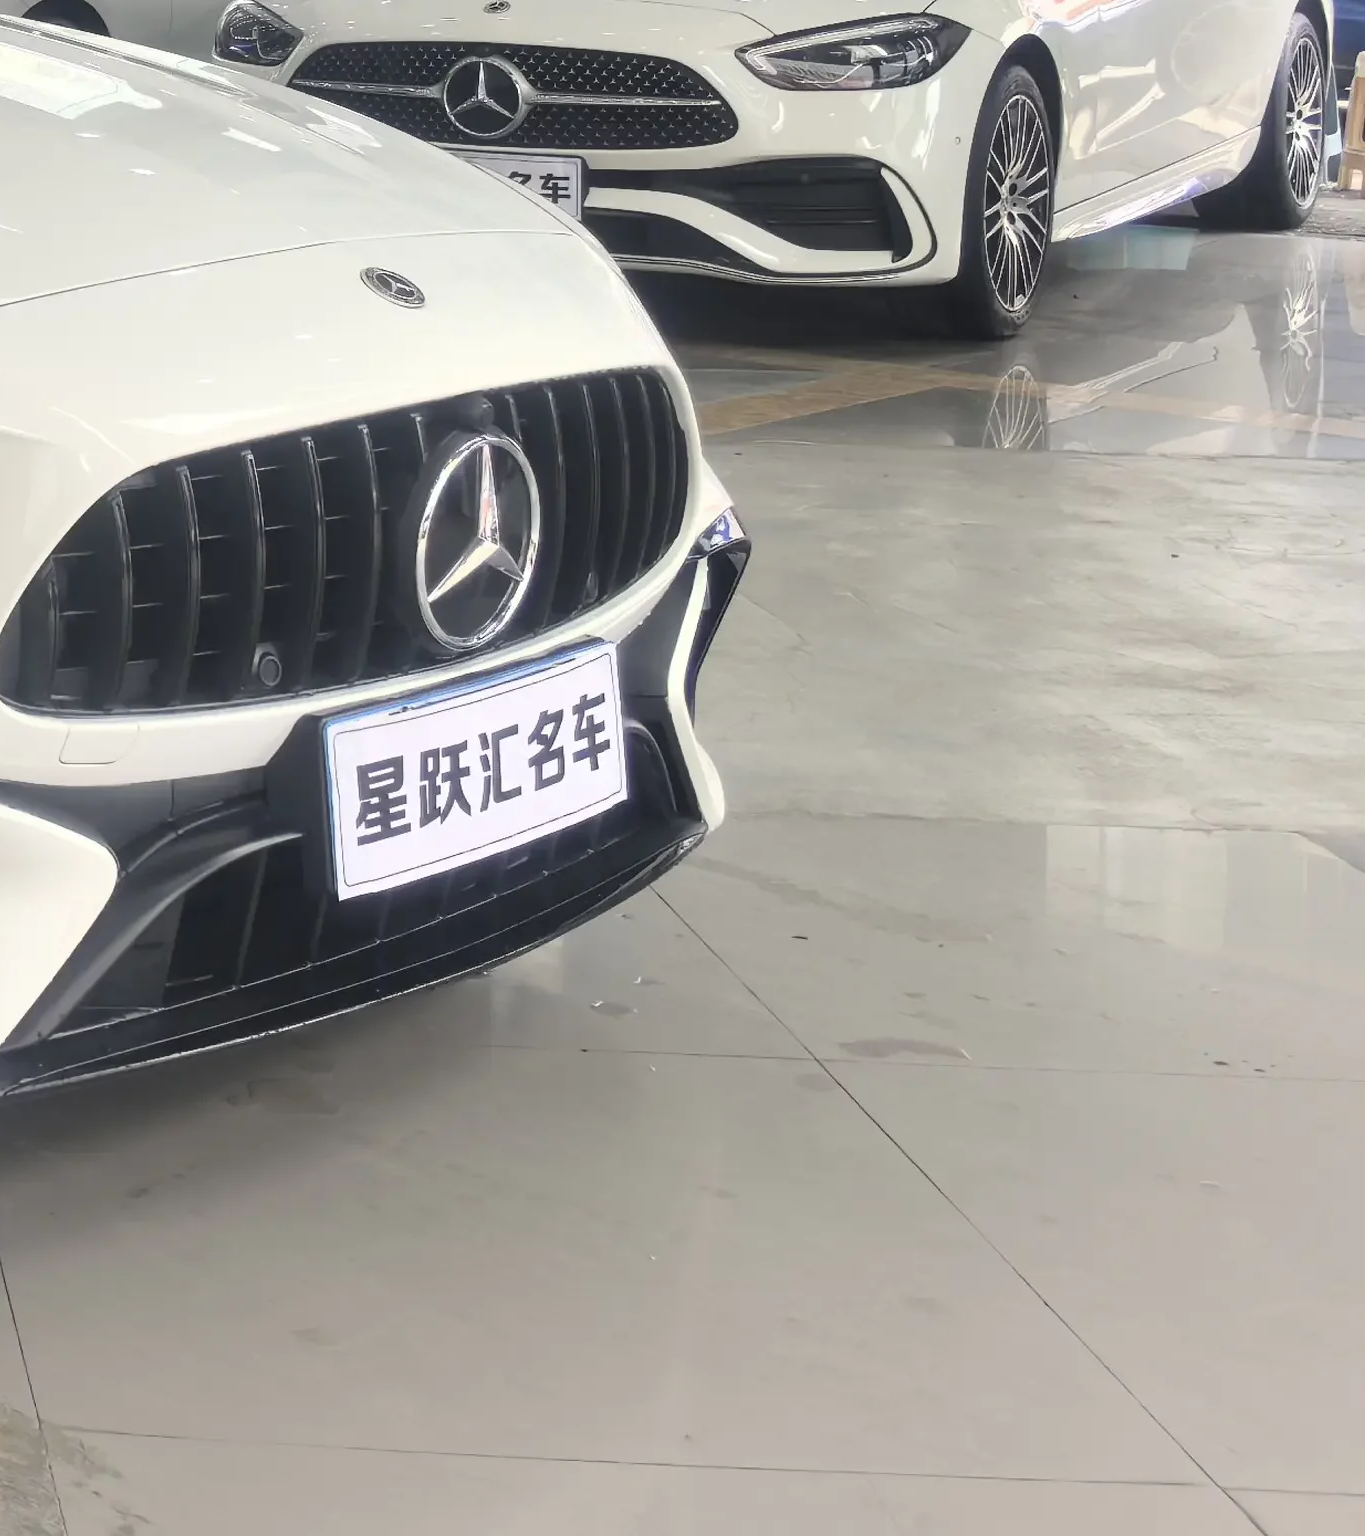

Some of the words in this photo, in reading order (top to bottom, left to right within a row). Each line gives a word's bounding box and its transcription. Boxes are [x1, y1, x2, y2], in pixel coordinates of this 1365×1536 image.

[355, 693, 611, 846] 星跃汇名车
